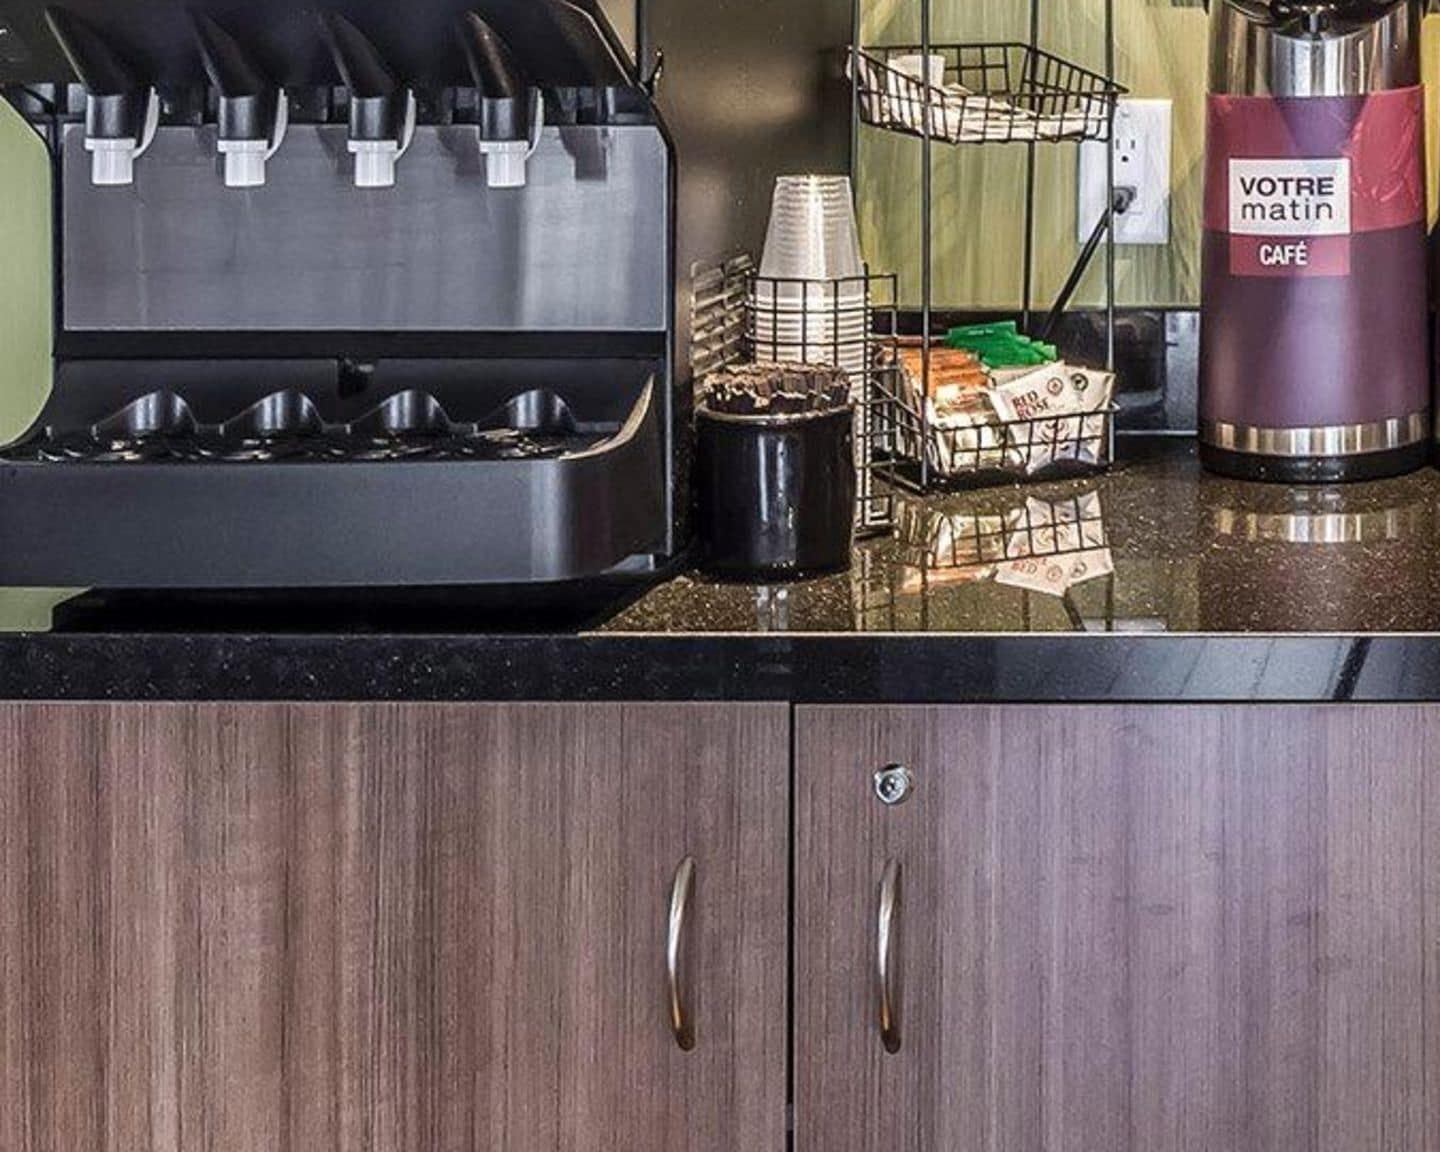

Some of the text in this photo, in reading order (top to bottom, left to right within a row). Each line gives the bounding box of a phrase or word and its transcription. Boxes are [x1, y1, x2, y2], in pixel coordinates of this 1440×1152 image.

[1239, 176, 1335, 197] VOTRE
[1241, 199, 1333, 221] matin
[1259, 240, 1308, 266] CAFÉ
